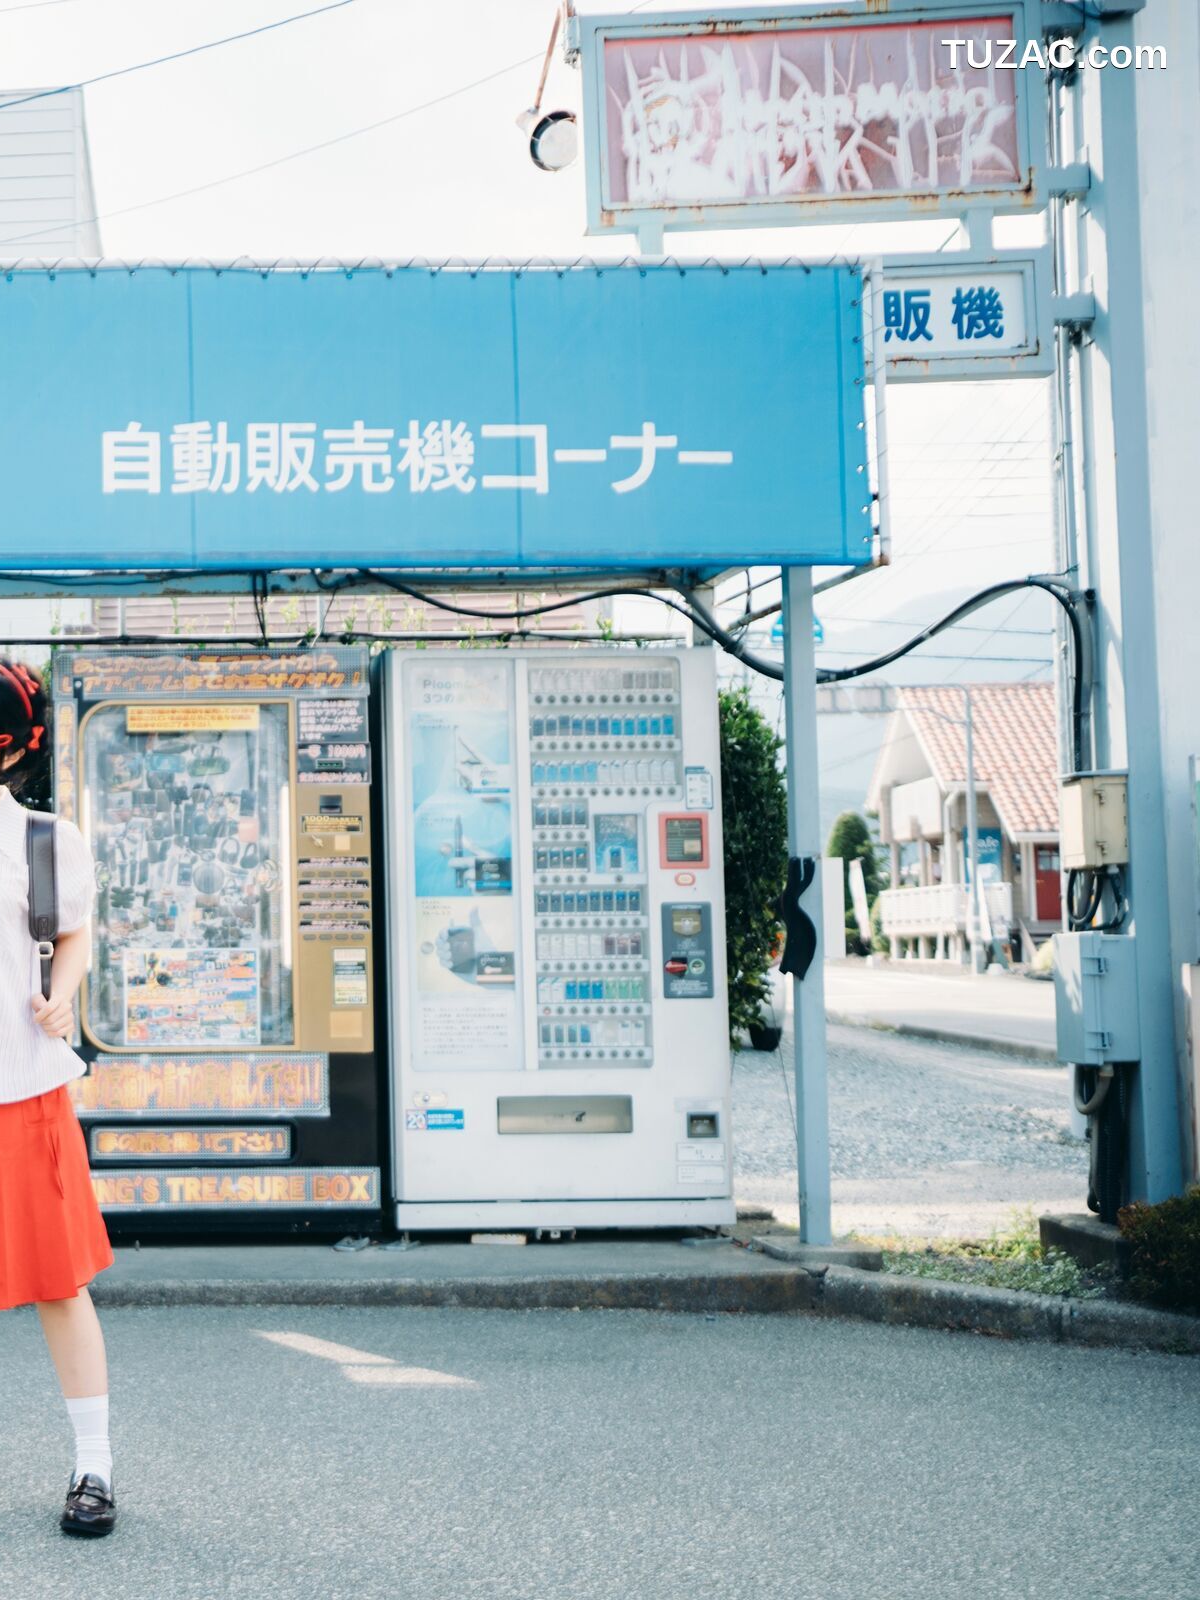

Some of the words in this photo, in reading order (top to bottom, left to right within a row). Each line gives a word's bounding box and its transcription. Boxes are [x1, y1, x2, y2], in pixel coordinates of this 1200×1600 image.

[883, 286, 1004, 342] 販機
[102, 419, 734, 494] 自動販売機コーナー
[91, 1176, 160, 1203] ING'S
[166, 1175, 304, 1202] TREASURE
[312, 1174, 371, 1201] BOX
